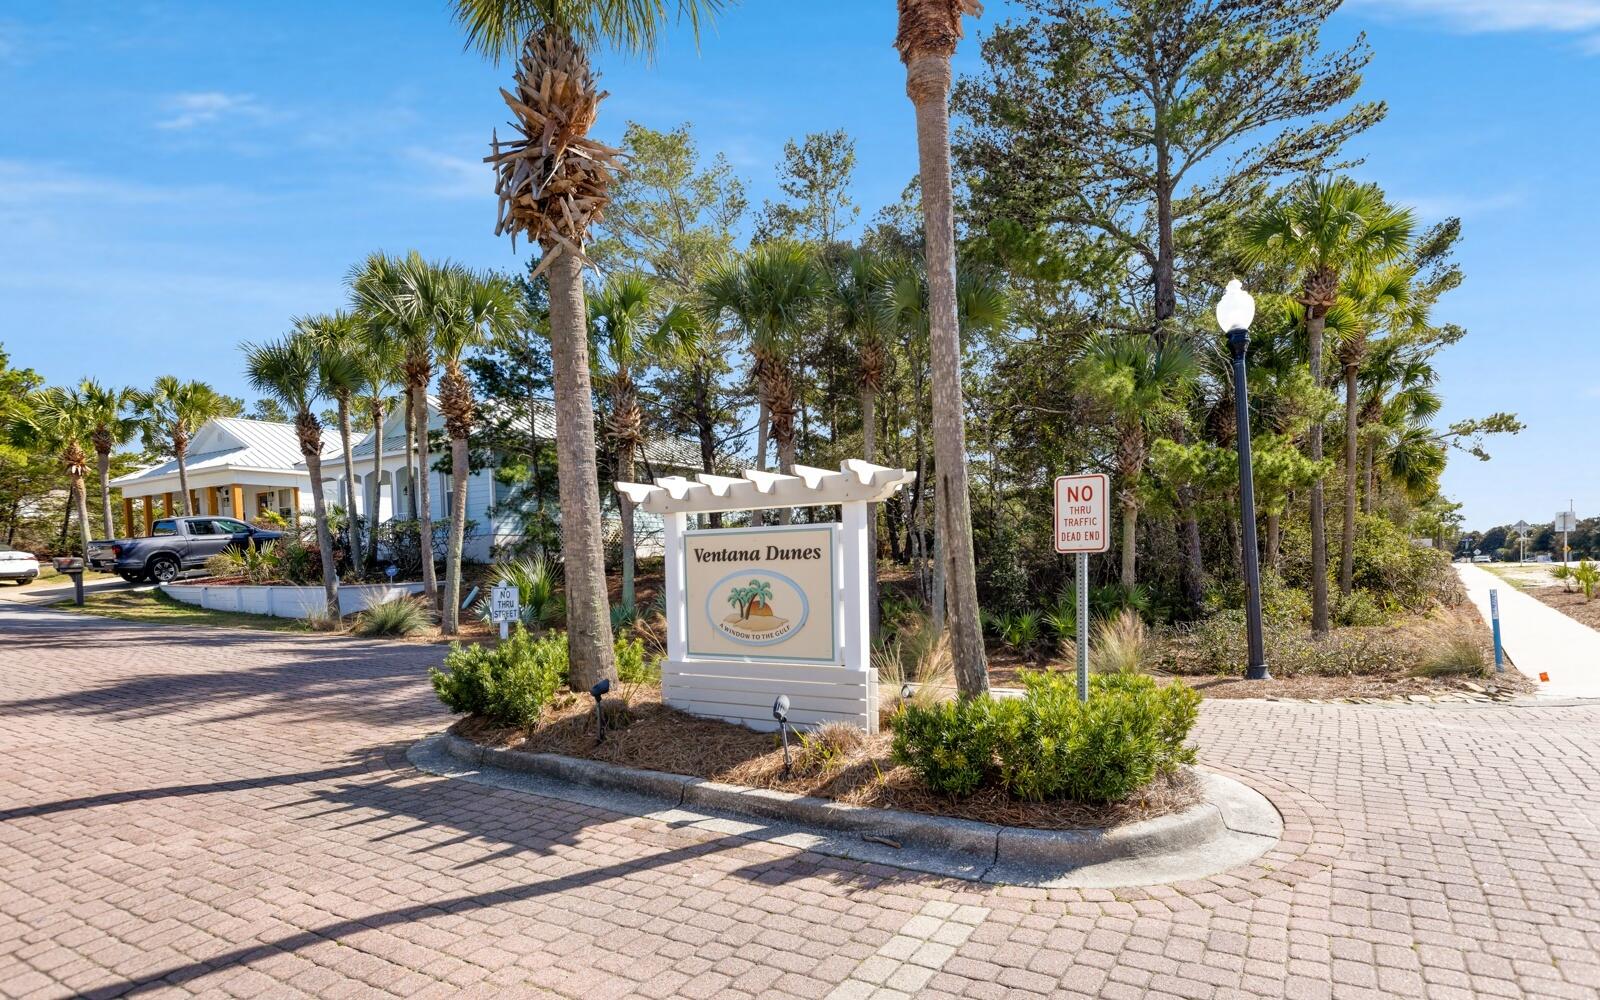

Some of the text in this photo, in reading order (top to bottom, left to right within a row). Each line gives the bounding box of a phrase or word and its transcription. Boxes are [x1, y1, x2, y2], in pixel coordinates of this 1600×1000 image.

[1067, 485, 1093, 502] NO
[1069, 505, 1092, 515] THRU
[1064, 517, 1097, 527] TRAFFIC
[1061, 530, 1100, 542] DEAD END
[693, 545, 822, 563] Ventana Dunes
[500, 590, 511, 599] NO
[497, 600, 514, 609] THRU
[493, 609, 517, 618] STREET
[724, 626, 750, 639] WINDOW
[775, 624, 791, 637] GULF
